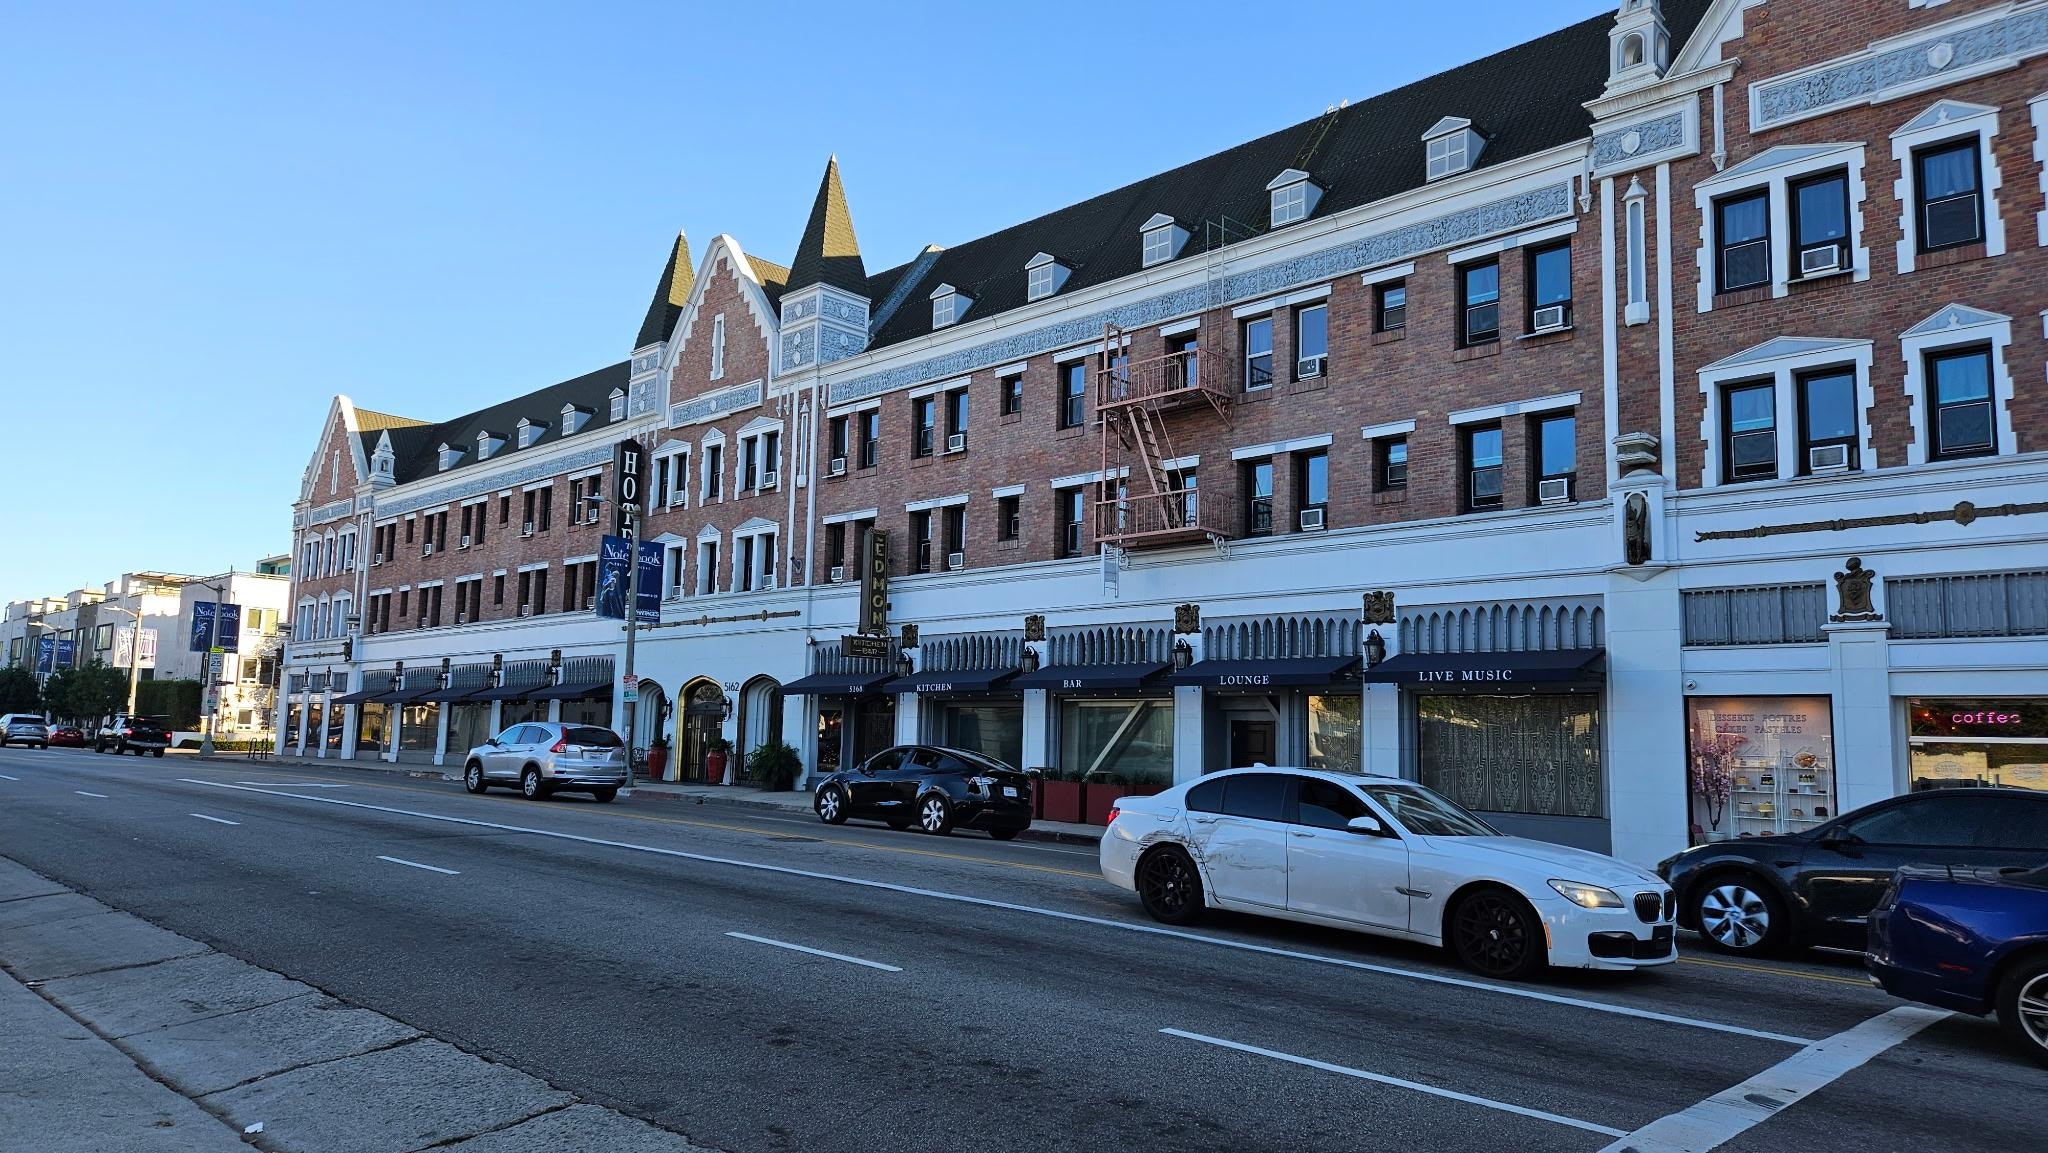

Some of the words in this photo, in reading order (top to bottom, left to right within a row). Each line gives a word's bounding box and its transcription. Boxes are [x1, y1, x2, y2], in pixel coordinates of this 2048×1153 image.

[604, 543, 661, 565] Noteook
[872, 542, 885, 625] EDMON
[852, 640, 887, 648] KITCHEN
[862, 646, 878, 655] BAR
[1219, 674, 1270, 685] LOUNGE
[1418, 671, 1454, 681] LIVE
[1461, 669, 1512, 681] MUSIC
[724, 681, 740, 692] 5162
[916, 682, 952, 692] KITCHEN
[1063, 679, 1082, 688] BAR
[849, 685, 863, 693] 5168
[1710, 714, 1755, 722] DESSERTS
[1762, 714, 1807, 723] POSTRES
[1715, 725, 1747, 734] CAKES
[1754, 725, 1802, 734] PASTELES
